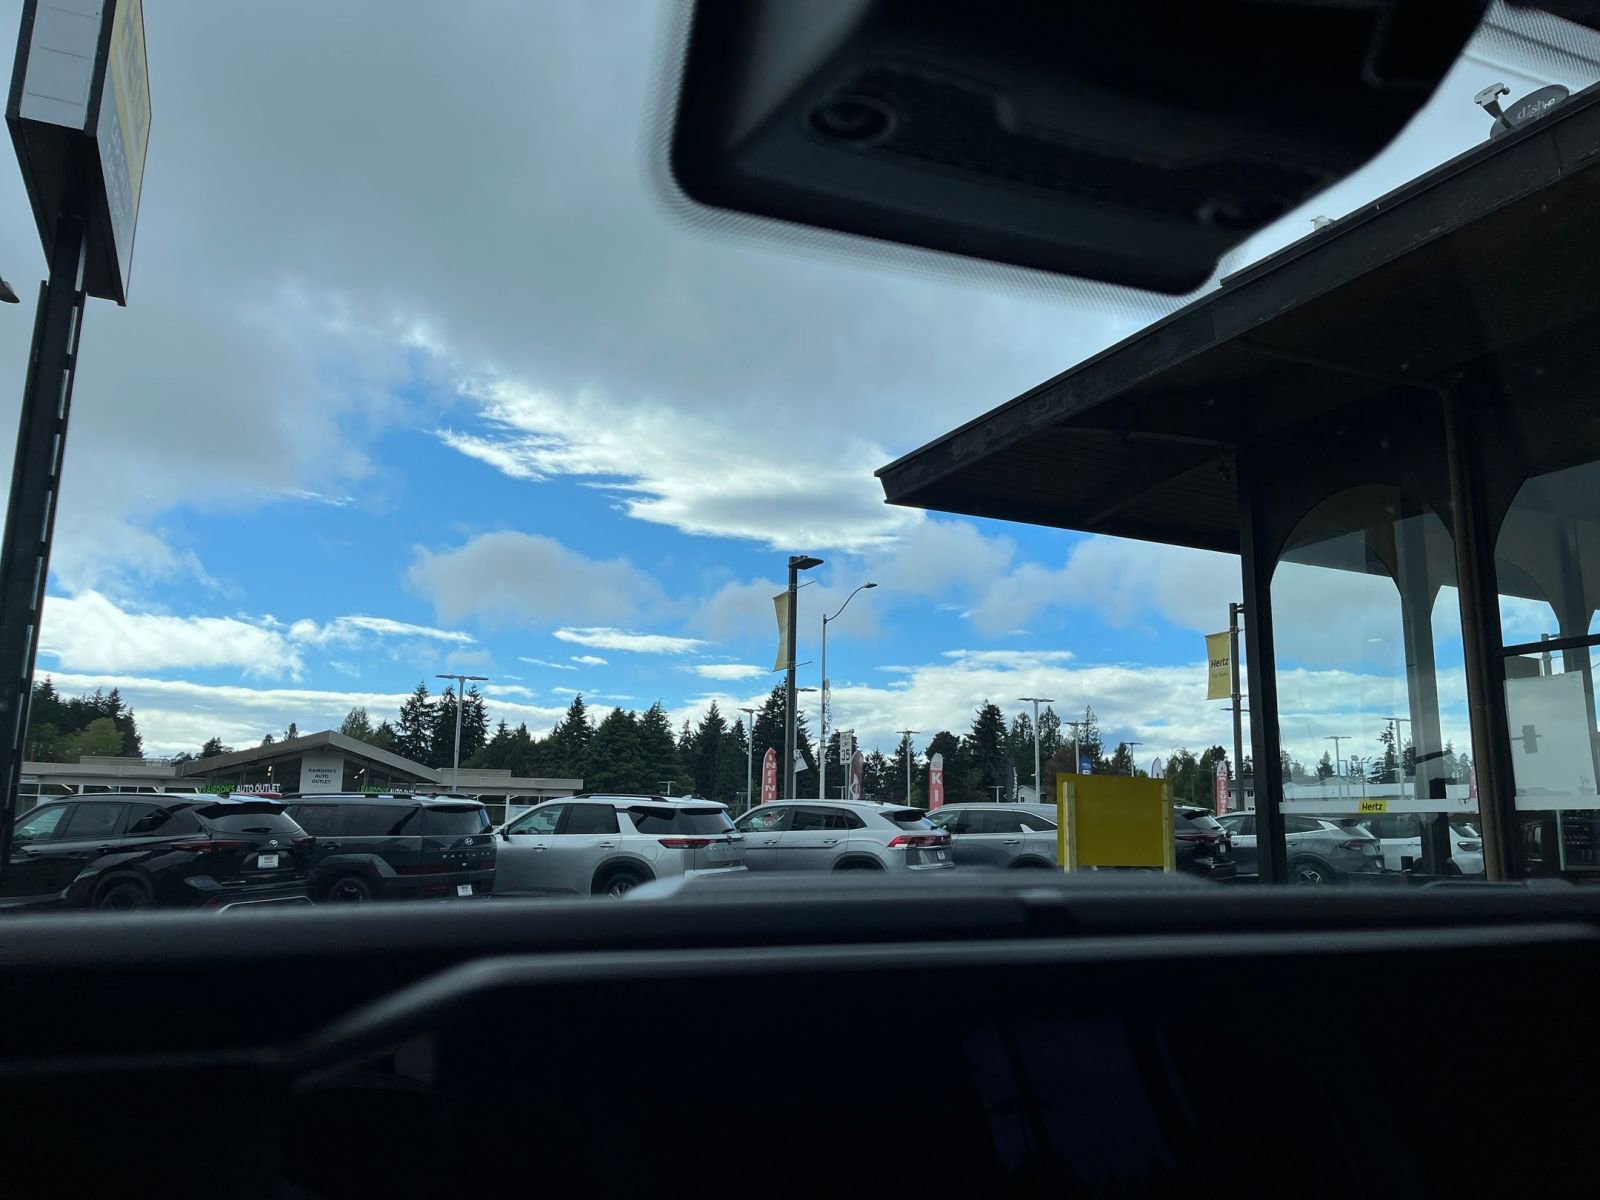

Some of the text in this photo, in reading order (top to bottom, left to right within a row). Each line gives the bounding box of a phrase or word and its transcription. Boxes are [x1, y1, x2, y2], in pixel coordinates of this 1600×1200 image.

[1517, 100, 1544, 119] dish
[1211, 657, 1229, 668] Hertz
[841, 749, 850, 761] 35
[765, 754, 776, 800] INFINI
[236, 784, 254, 793] AUTO
[254, 783, 280, 793] OUTLET
[931, 772, 942, 802] KI
[1362, 802, 1383, 811] Hertz
